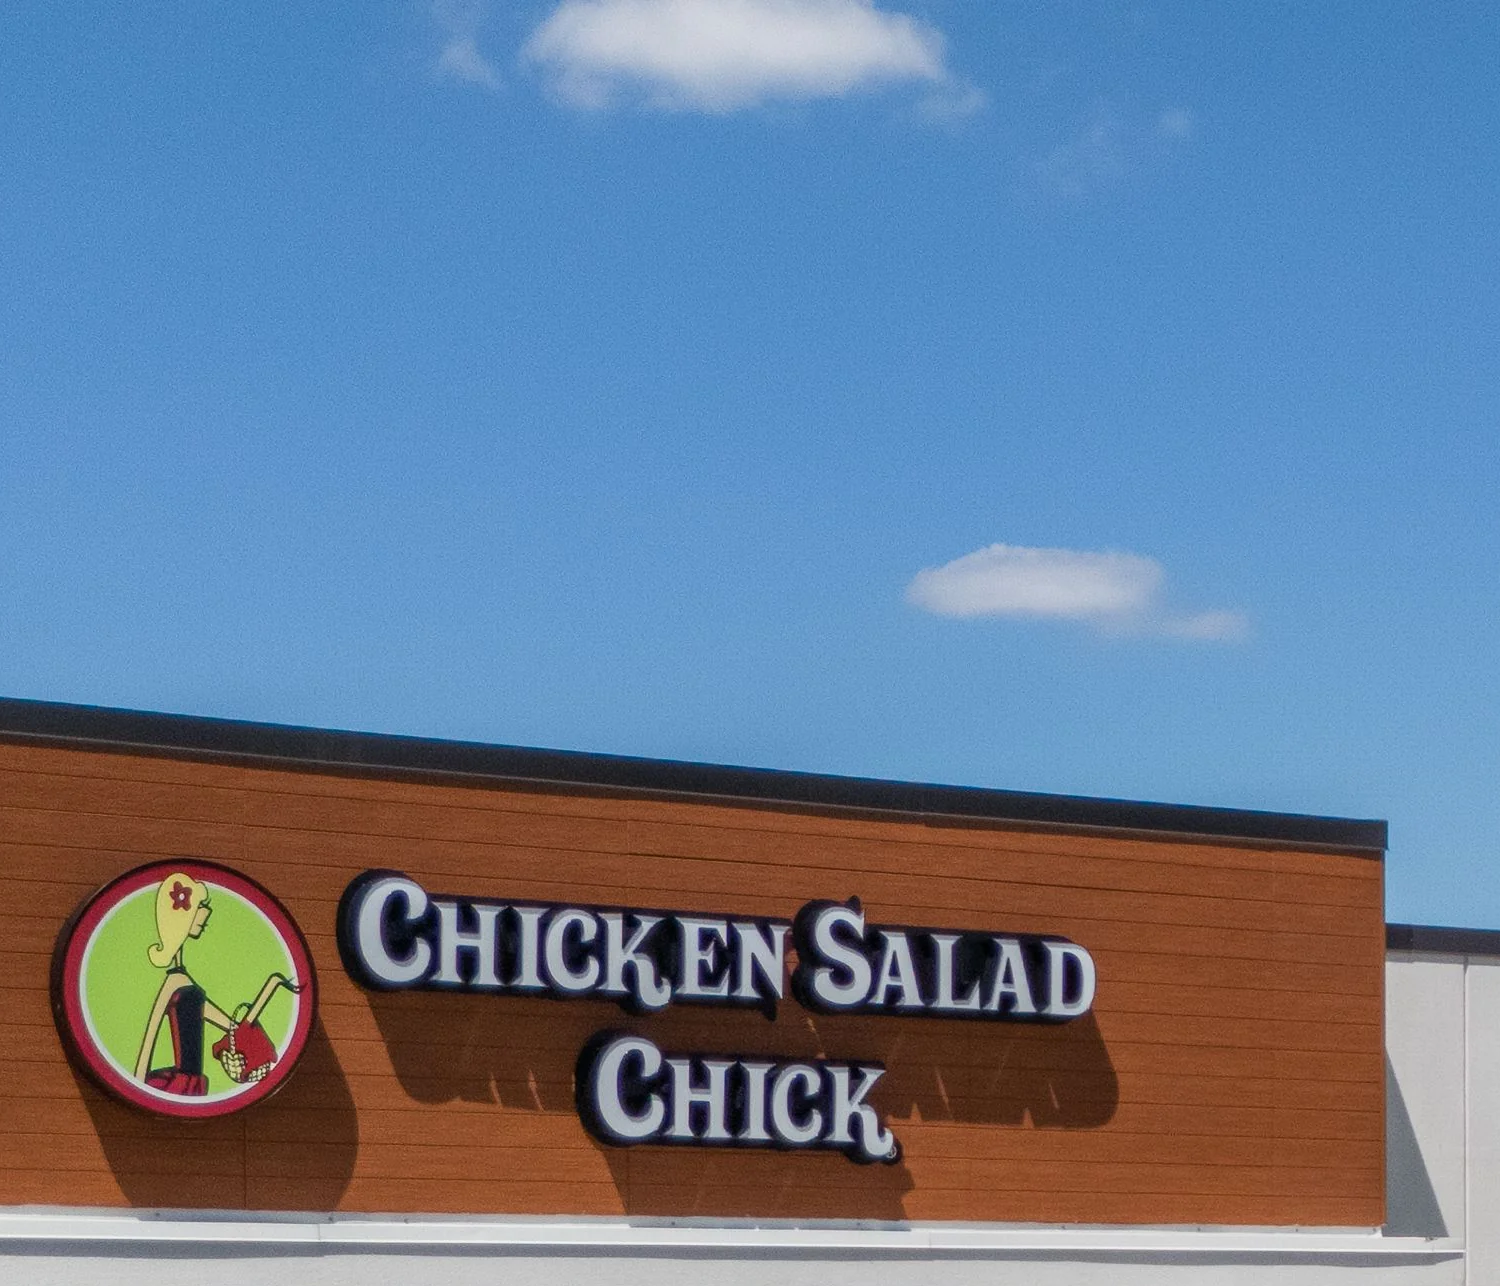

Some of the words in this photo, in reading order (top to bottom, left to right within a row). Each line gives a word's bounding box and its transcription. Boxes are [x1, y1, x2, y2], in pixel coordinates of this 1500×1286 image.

[357, 876, 790, 1012] CHICKEN
[813, 905, 1097, 1018] SALAD
[597, 1036, 894, 1156] CHICK
